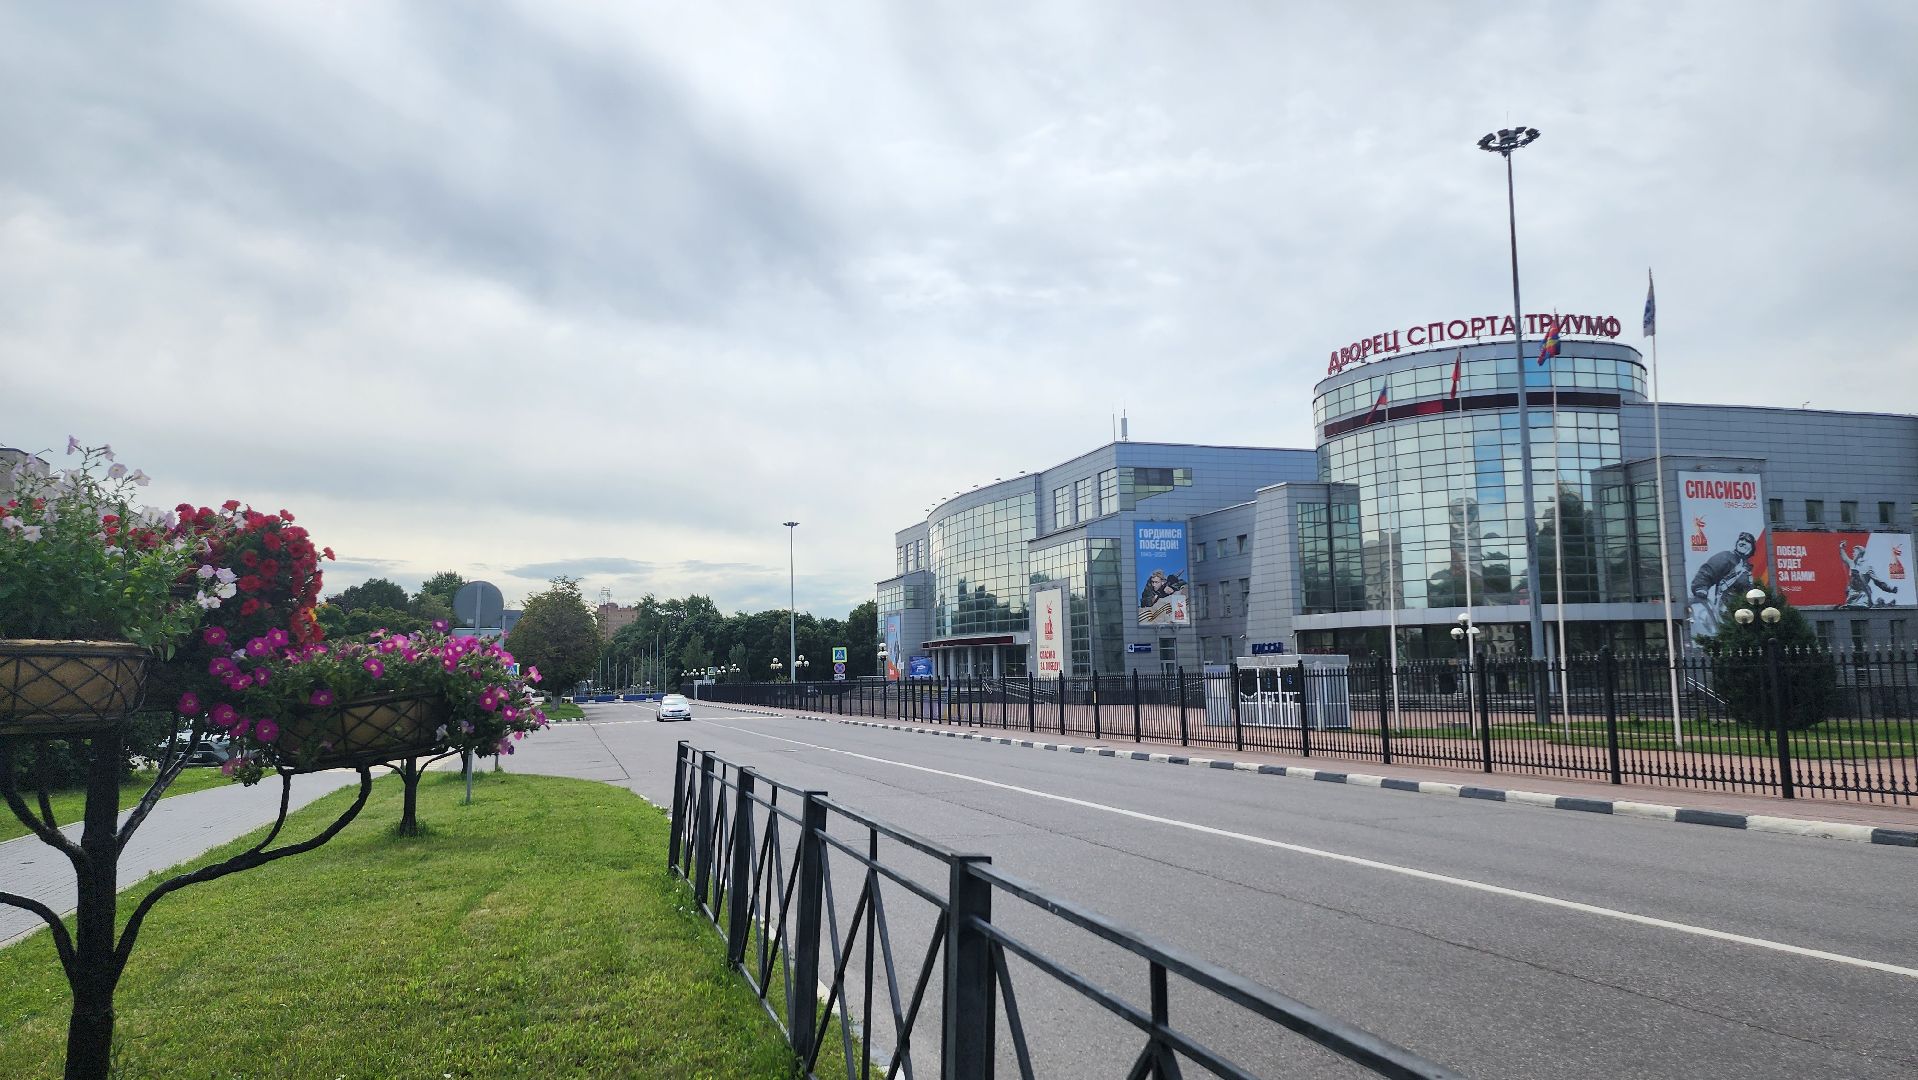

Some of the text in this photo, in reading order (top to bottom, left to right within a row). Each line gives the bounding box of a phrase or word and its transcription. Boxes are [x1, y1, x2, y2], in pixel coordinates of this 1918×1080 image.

[1327, 314, 1621, 375] ДВОРЕЦ СПОРТА ТРИУМФ
[1686, 480, 1757, 500] СПАСИБО!
[1139, 528, 1182, 539] ГОРДИМСЯ
[1140, 540, 1179, 551] ПОБЕДОЙ!
[1776, 546, 1807, 557] ПОБЕДА
[1777, 559, 1802, 570] БУДЕТ
[1778, 571, 1816, 581] ЗА НАМИ!
